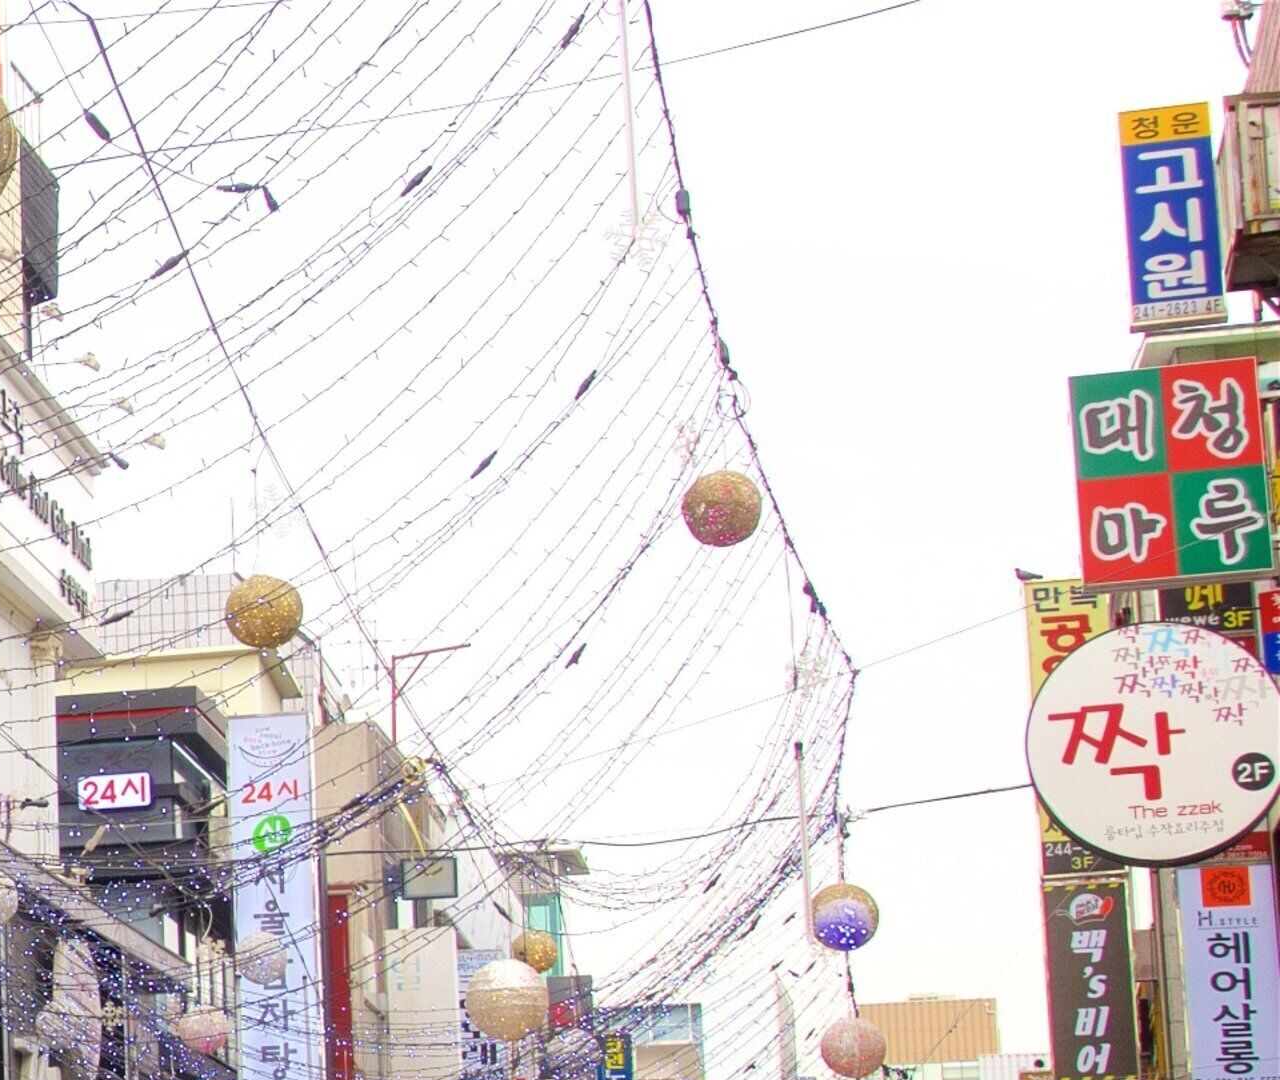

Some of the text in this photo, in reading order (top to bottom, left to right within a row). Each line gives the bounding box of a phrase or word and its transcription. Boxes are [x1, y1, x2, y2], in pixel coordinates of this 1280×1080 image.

[1131, 111, 1200, 140] 청운
[1134, 146, 1207, 300] 고시원
[1133, 299, 1222, 320] 241-2623 4F
[1080, 377, 1249, 461] 대청
[1092, 478, 1264, 565] 마루
[1223, 609, 1252, 629] 3F
[1047, 702, 1186, 801] 짝
[1236, 762, 1270, 784] 2F
[81, 775, 148, 807] 24시
[240, 778, 301, 805] 24시
[1128, 800, 1224, 820] The zzak
[259, 816, 291, 850] 신
[1147, 818, 1226, 838] 수작요리주점
[1071, 855, 1094, 870] 3F
[1070, 929, 1112, 1074] 백's비어
[1206, 930, 1260, 1075] 헤어살롱
